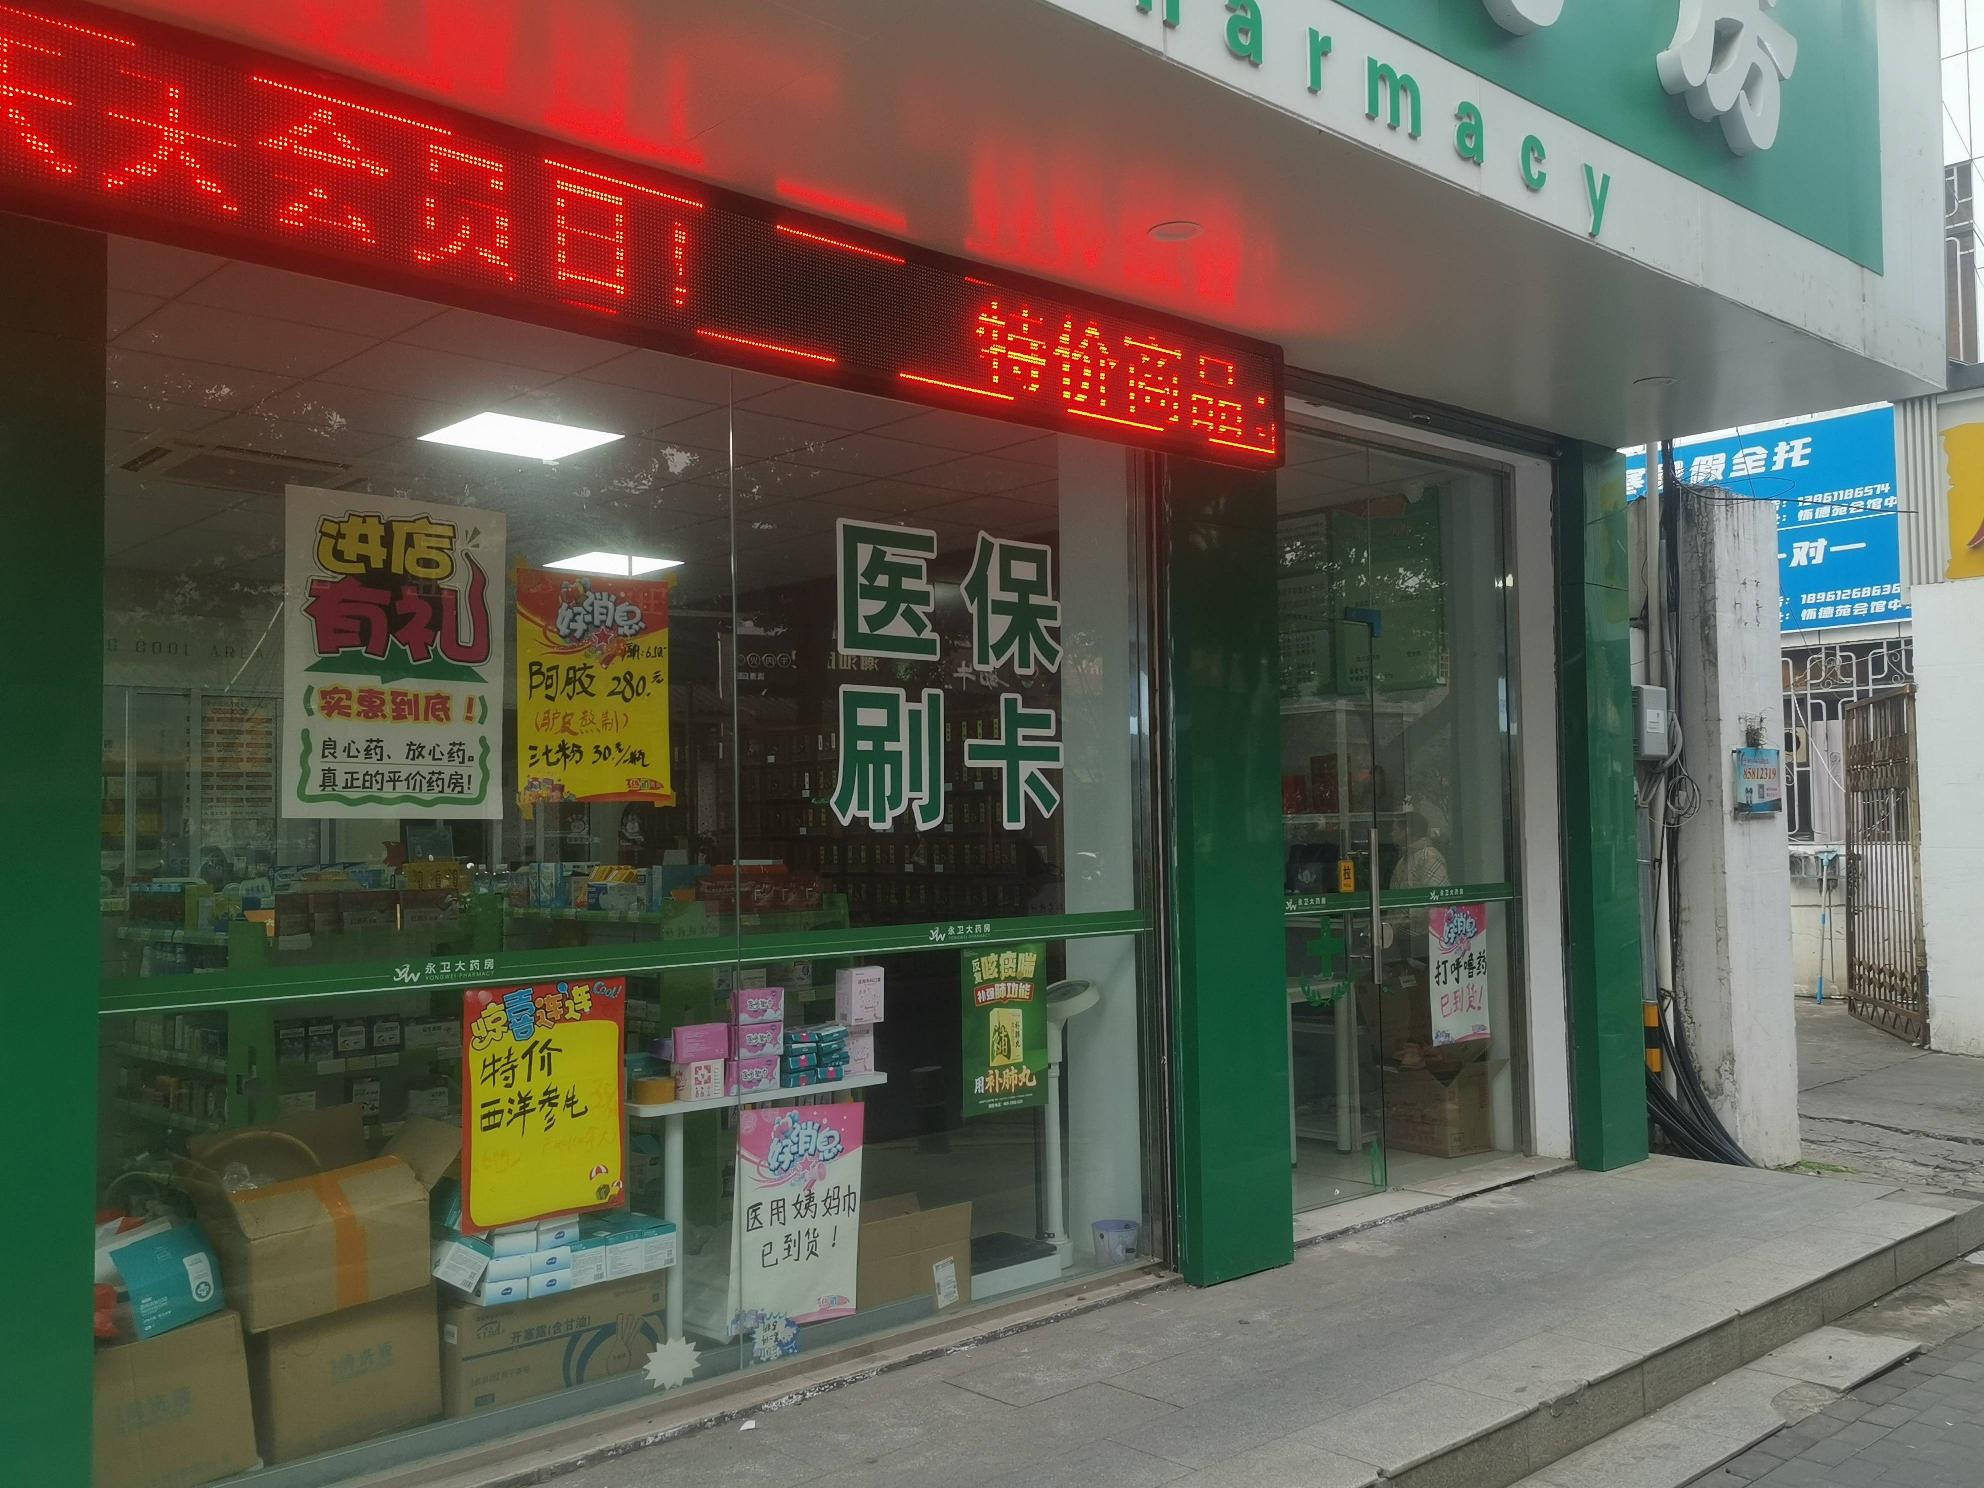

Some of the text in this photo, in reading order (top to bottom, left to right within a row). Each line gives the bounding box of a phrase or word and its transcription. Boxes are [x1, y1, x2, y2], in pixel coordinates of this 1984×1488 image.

[315, 512, 458, 579] 进店
[303, 551, 491, 665] 有礼
[556, 591, 646, 639] 好消息
[836, 518, 1063, 674] 医保
[1801, 583, 1900, 604] 18961268636
[528, 661, 597, 702] 阿胶
[319, 686, 476, 723] 实惠到底!
[830, 684, 1064, 831] 刷卡
[1744, 768, 1776, 779] 85812319
[319, 767, 473, 794] 真正的平价药房!
[948, 924, 991, 936] 永卫大药房
[1444, 912, 1477, 945] 好消息
[425, 958, 495, 974] 永卫大药房
[1434, 949, 1487, 987] 打呼噜药
[471, 983, 592, 1051] 惊喜连连
[480, 1038, 562, 1088] 特价
[767, 1120, 844, 1173] 好消息
[746, 1184, 857, 1232] 医用姨妈巾
[762, 1225, 838, 1268] 已到货!
